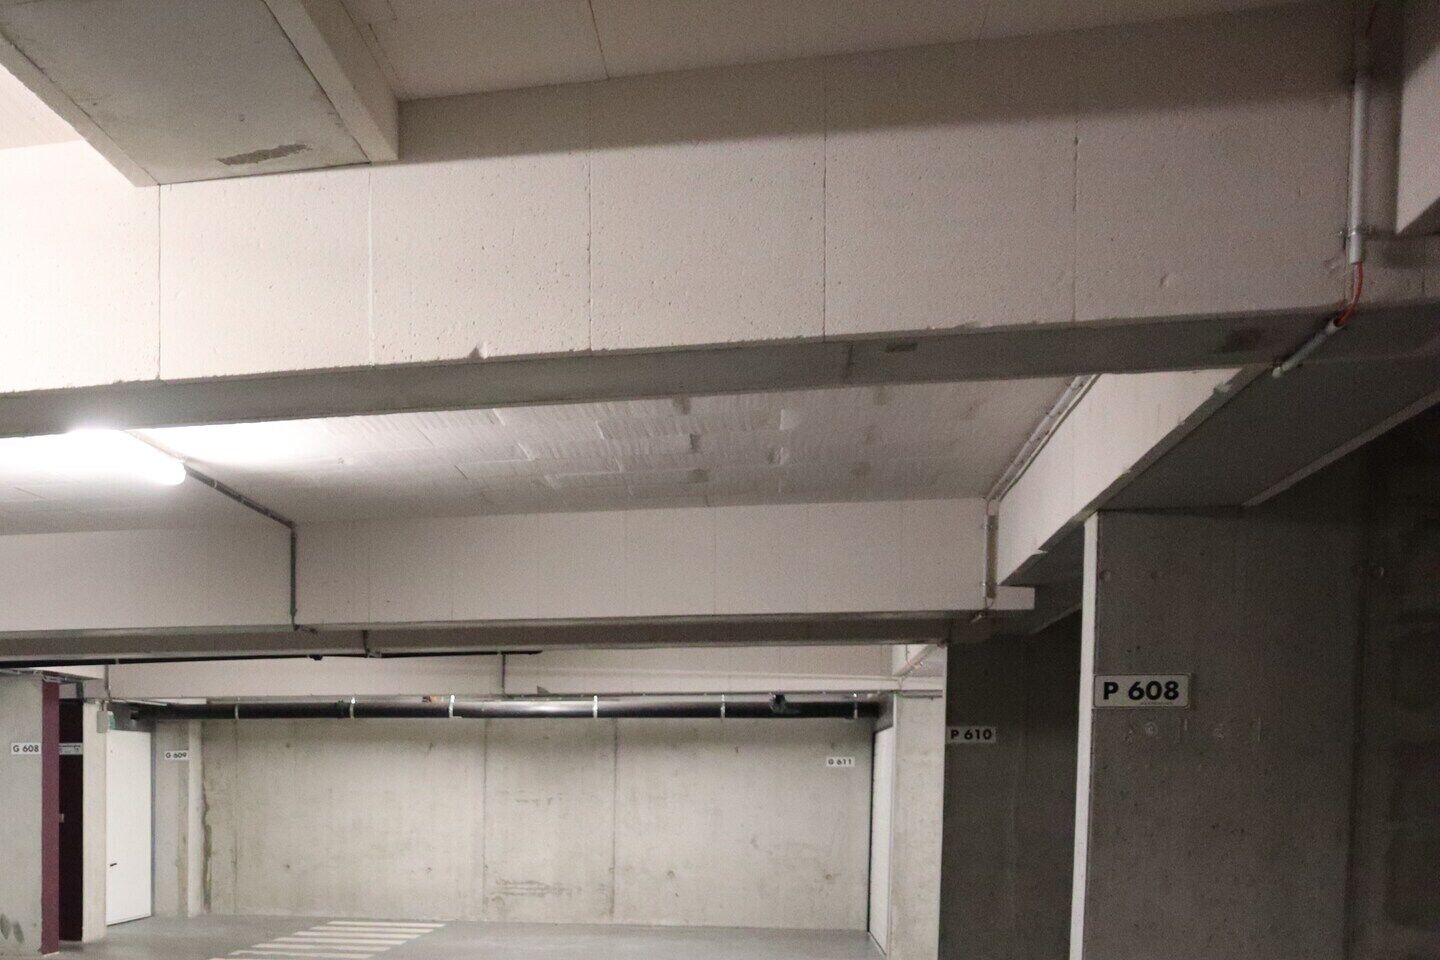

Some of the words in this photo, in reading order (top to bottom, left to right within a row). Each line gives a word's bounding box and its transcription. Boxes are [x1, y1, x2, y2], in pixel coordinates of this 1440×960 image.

[1103, 681, 1119, 700] P
[1128, 680, 1180, 701] 608
[951, 730, 959, 740] P
[964, 729, 992, 740] 610
[12, 744, 20, 752] G
[22, 744, 40, 752] 608
